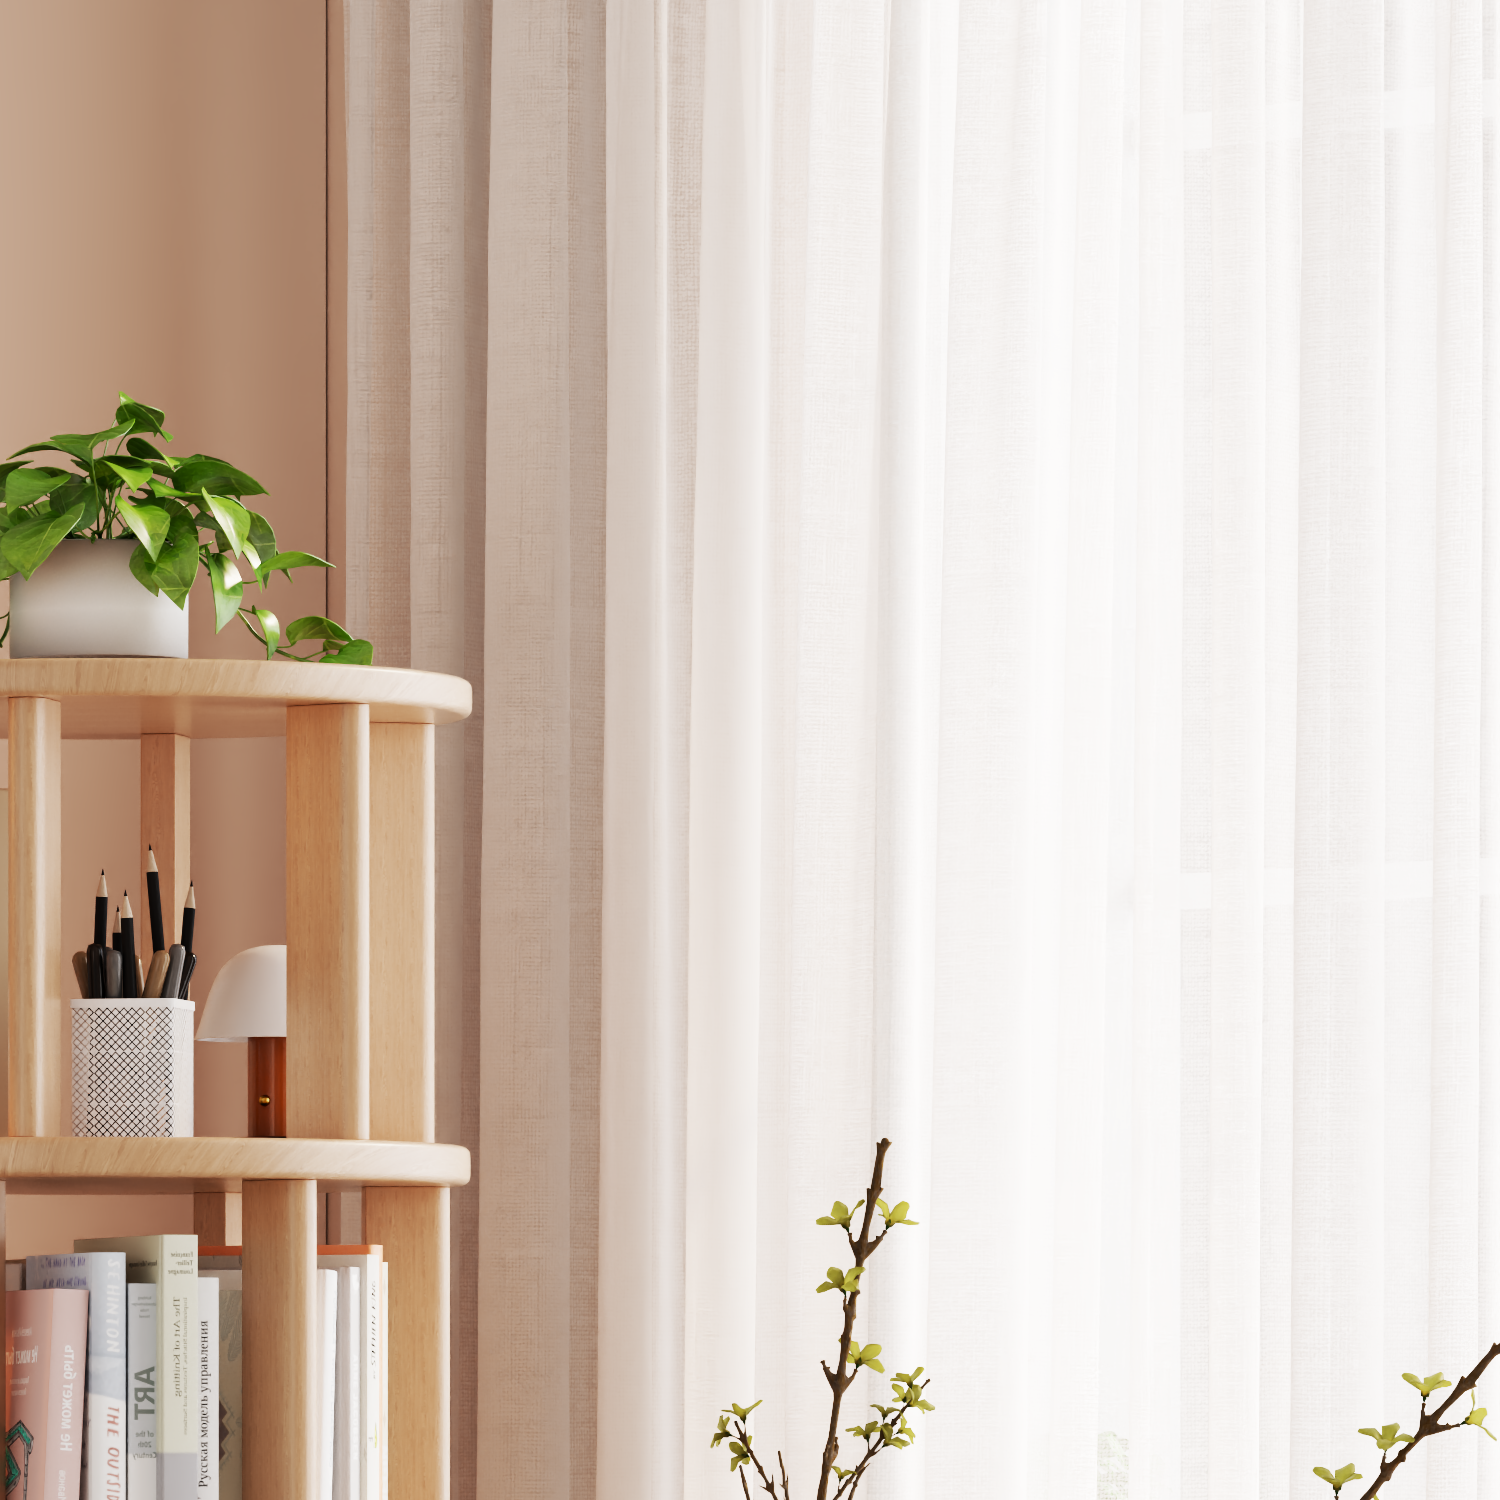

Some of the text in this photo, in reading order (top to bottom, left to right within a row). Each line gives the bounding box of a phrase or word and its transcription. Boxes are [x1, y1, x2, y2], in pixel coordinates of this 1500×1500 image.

[106, 1284, 120, 1353] HINTON
[106, 1406, 120, 1437] THE
[198, 1320, 211, 1488] Русская модель управления
